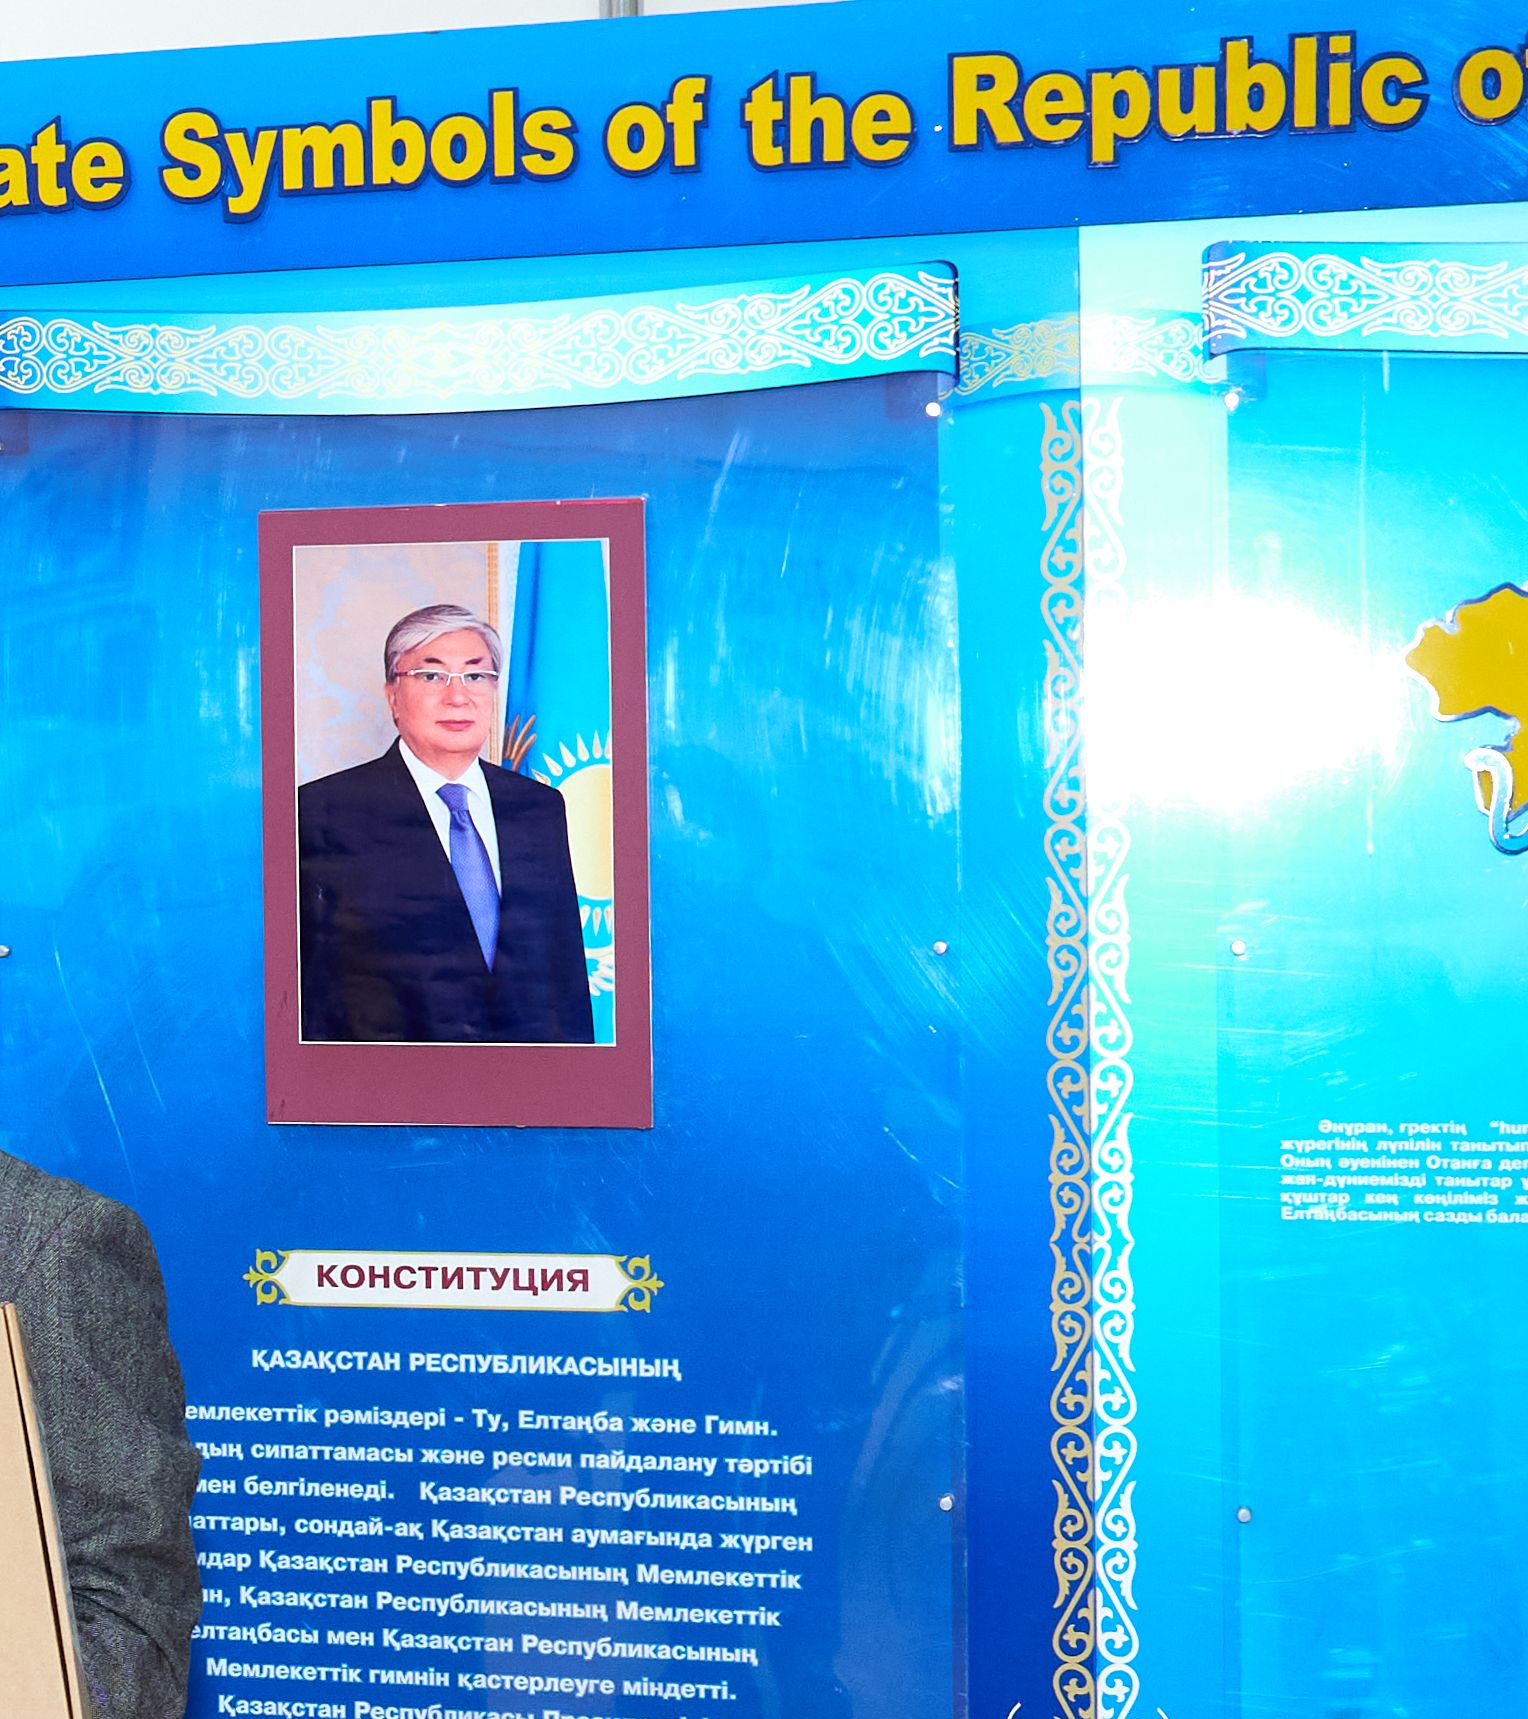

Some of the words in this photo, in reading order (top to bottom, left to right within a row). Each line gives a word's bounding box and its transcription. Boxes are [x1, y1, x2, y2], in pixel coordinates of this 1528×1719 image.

[162, 93, 574, 212] Symbols
[606, 78, 706, 171] of
[744, 76, 912, 165] the
[953, 36, 1429, 164] Republic
[1458, 49, 1528, 121] o
[1317, 1119, 1394, 1137] Әнұран,
[1399, 1120, 1468, 1136] гректің
[1279, 1153, 1333, 1170] Оның
[1425, 1155, 1493, 1170] Отанға
[1280, 1137, 1369, 1155] жүрегінің
[1280, 1173, 1427, 1188] жан-дүниемізді
[1280, 1192, 1351, 1207] құштар
[1413, 1191, 1499, 1207] көңіліміз
[1280, 1207, 1421, 1223] Елтаңбасының
[316, 1265, 590, 1296] КОНСТИТУЦИЯ
[251, 1349, 401, 1372] ҚАЗАҚСТАН
[409, 1353, 682, 1380] РЕСПУБЛИКАСЫНЫҢ
[324, 1407, 446, 1430] рәміздері
[471, 1408, 509, 1432] Ту,
[518, 1410, 624, 1433] Елтаңба
[630, 1417, 697, 1434] және
[705, 1415, 778, 1436] Гимн.
[250, 1444, 414, 1462] сипаттамасы
[420, 1449, 485, 1465] және
[492, 1451, 572, 1470] ресми
[580, 1450, 718, 1476] пайдалану
[724, 1455, 813, 1478] тәртібі
[243, 1476, 395, 1501] белгіленеді.
[419, 1482, 552, 1505] Қазақстан
[559, 1486, 798, 1515] Республикасының
[294, 1517, 424, 1540] сондай-ақ
[431, 1519, 564, 1543] Қазақстан
[571, 1528, 713, 1550] аумағында
[720, 1534, 813, 1554] жүрген
[259, 1550, 388, 1573] Қазақстан
[396, 1555, 629, 1585] Республикасының
[636, 1564, 801, 1589] Мемлекеттік
[239, 1586, 368, 1609] Қазақстан
[376, 1591, 609, 1621] Республикасының
[615, 1600, 781, 1626] Мемлекеттік
[327, 1630, 375, 1646] мен
[382, 1628, 514, 1653] Қазақстан
[521, 1634, 759, 1666] Республикасының
[206, 1658, 362, 1682] Мемлекеттік
[369, 1668, 450, 1686] гимнін
[457, 1674, 616, 1697] қастерлеуге
[622, 1677, 737, 1700] міндетті.
[218, 1695, 346, 1719] Қазақстан
